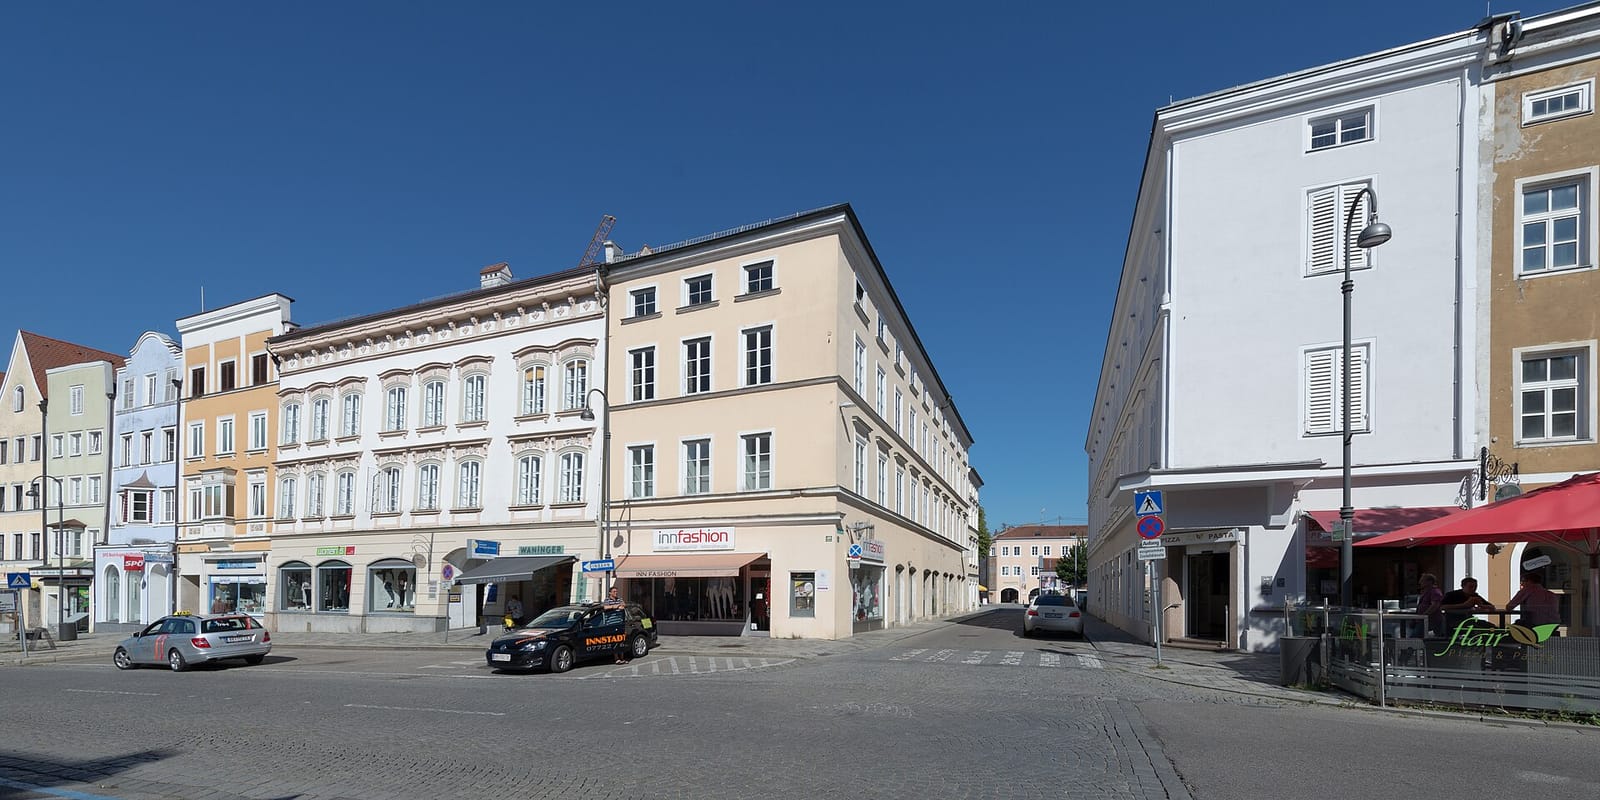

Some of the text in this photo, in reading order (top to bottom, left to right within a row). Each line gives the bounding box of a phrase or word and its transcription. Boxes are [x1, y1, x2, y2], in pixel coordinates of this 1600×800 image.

[658, 529, 728, 544] innfashion
[1208, 531, 1234, 539] PASTA
[124, 559, 143, 567] SPÖ
[1434, 614, 1509, 657] flair
[1495, 650, 1504, 659] &
